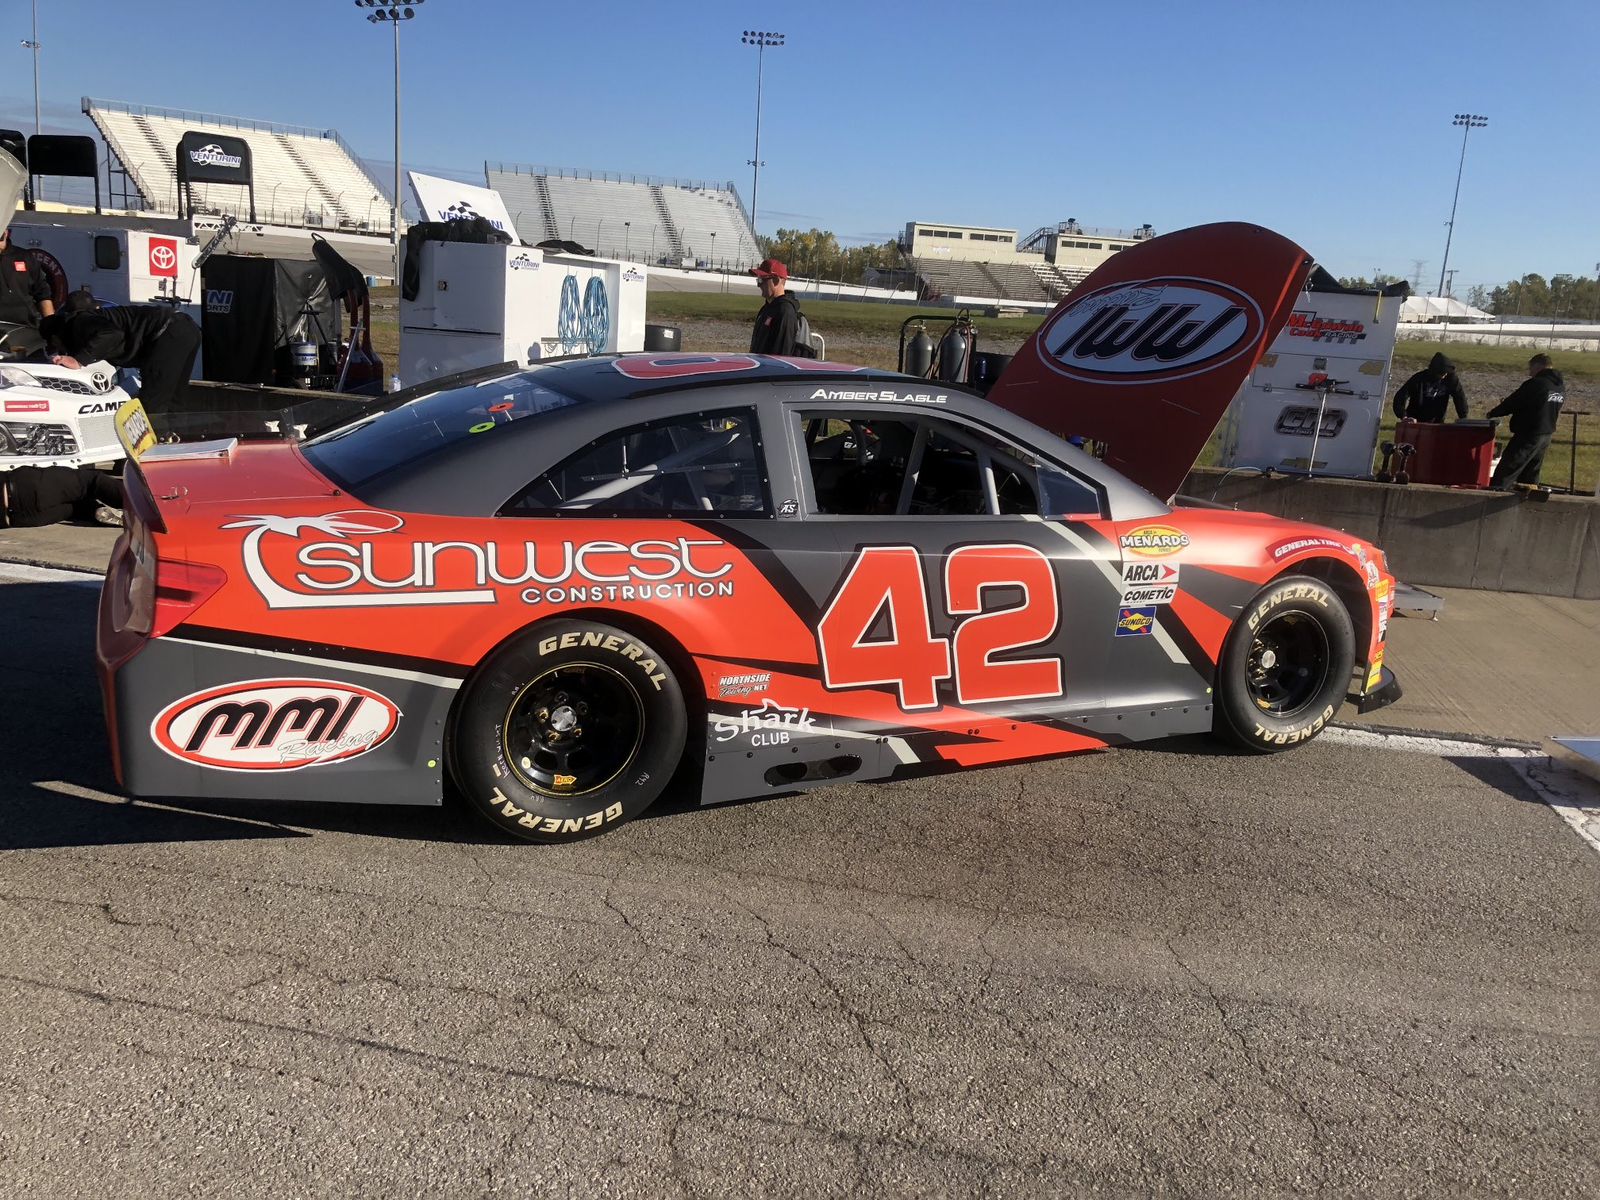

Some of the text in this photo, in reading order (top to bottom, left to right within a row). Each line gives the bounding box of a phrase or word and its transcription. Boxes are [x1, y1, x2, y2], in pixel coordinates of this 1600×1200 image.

[190, 151, 242, 164] VENTURINI
[509, 259, 540, 268] VENTURINI
[1051, 303, 1248, 363] MMI
[809, 388, 948, 404] AMBER SLAGLE
[1119, 534, 1190, 549] MENARDS
[1274, 539, 1321, 558] GENERAL
[296, 536, 735, 588] sunwest
[1124, 564, 1160, 582] ARCA
[521, 581, 735, 605] CONSTRUCTION
[1246, 585, 1330, 631] GENERAL
[817, 543, 1064, 710] 42
[1119, 617, 1153, 628] SUNOCO
[538, 631, 668, 691] GENERAL
[718, 672, 773, 687] NORTHSIDE
[183, 694, 368, 753] MMI
[1254, 704, 1335, 745] GENERAL
[276, 729, 381, 765] Racing
[751, 731, 790, 747] CLUB
[489, 786, 624, 834] GENERAL
